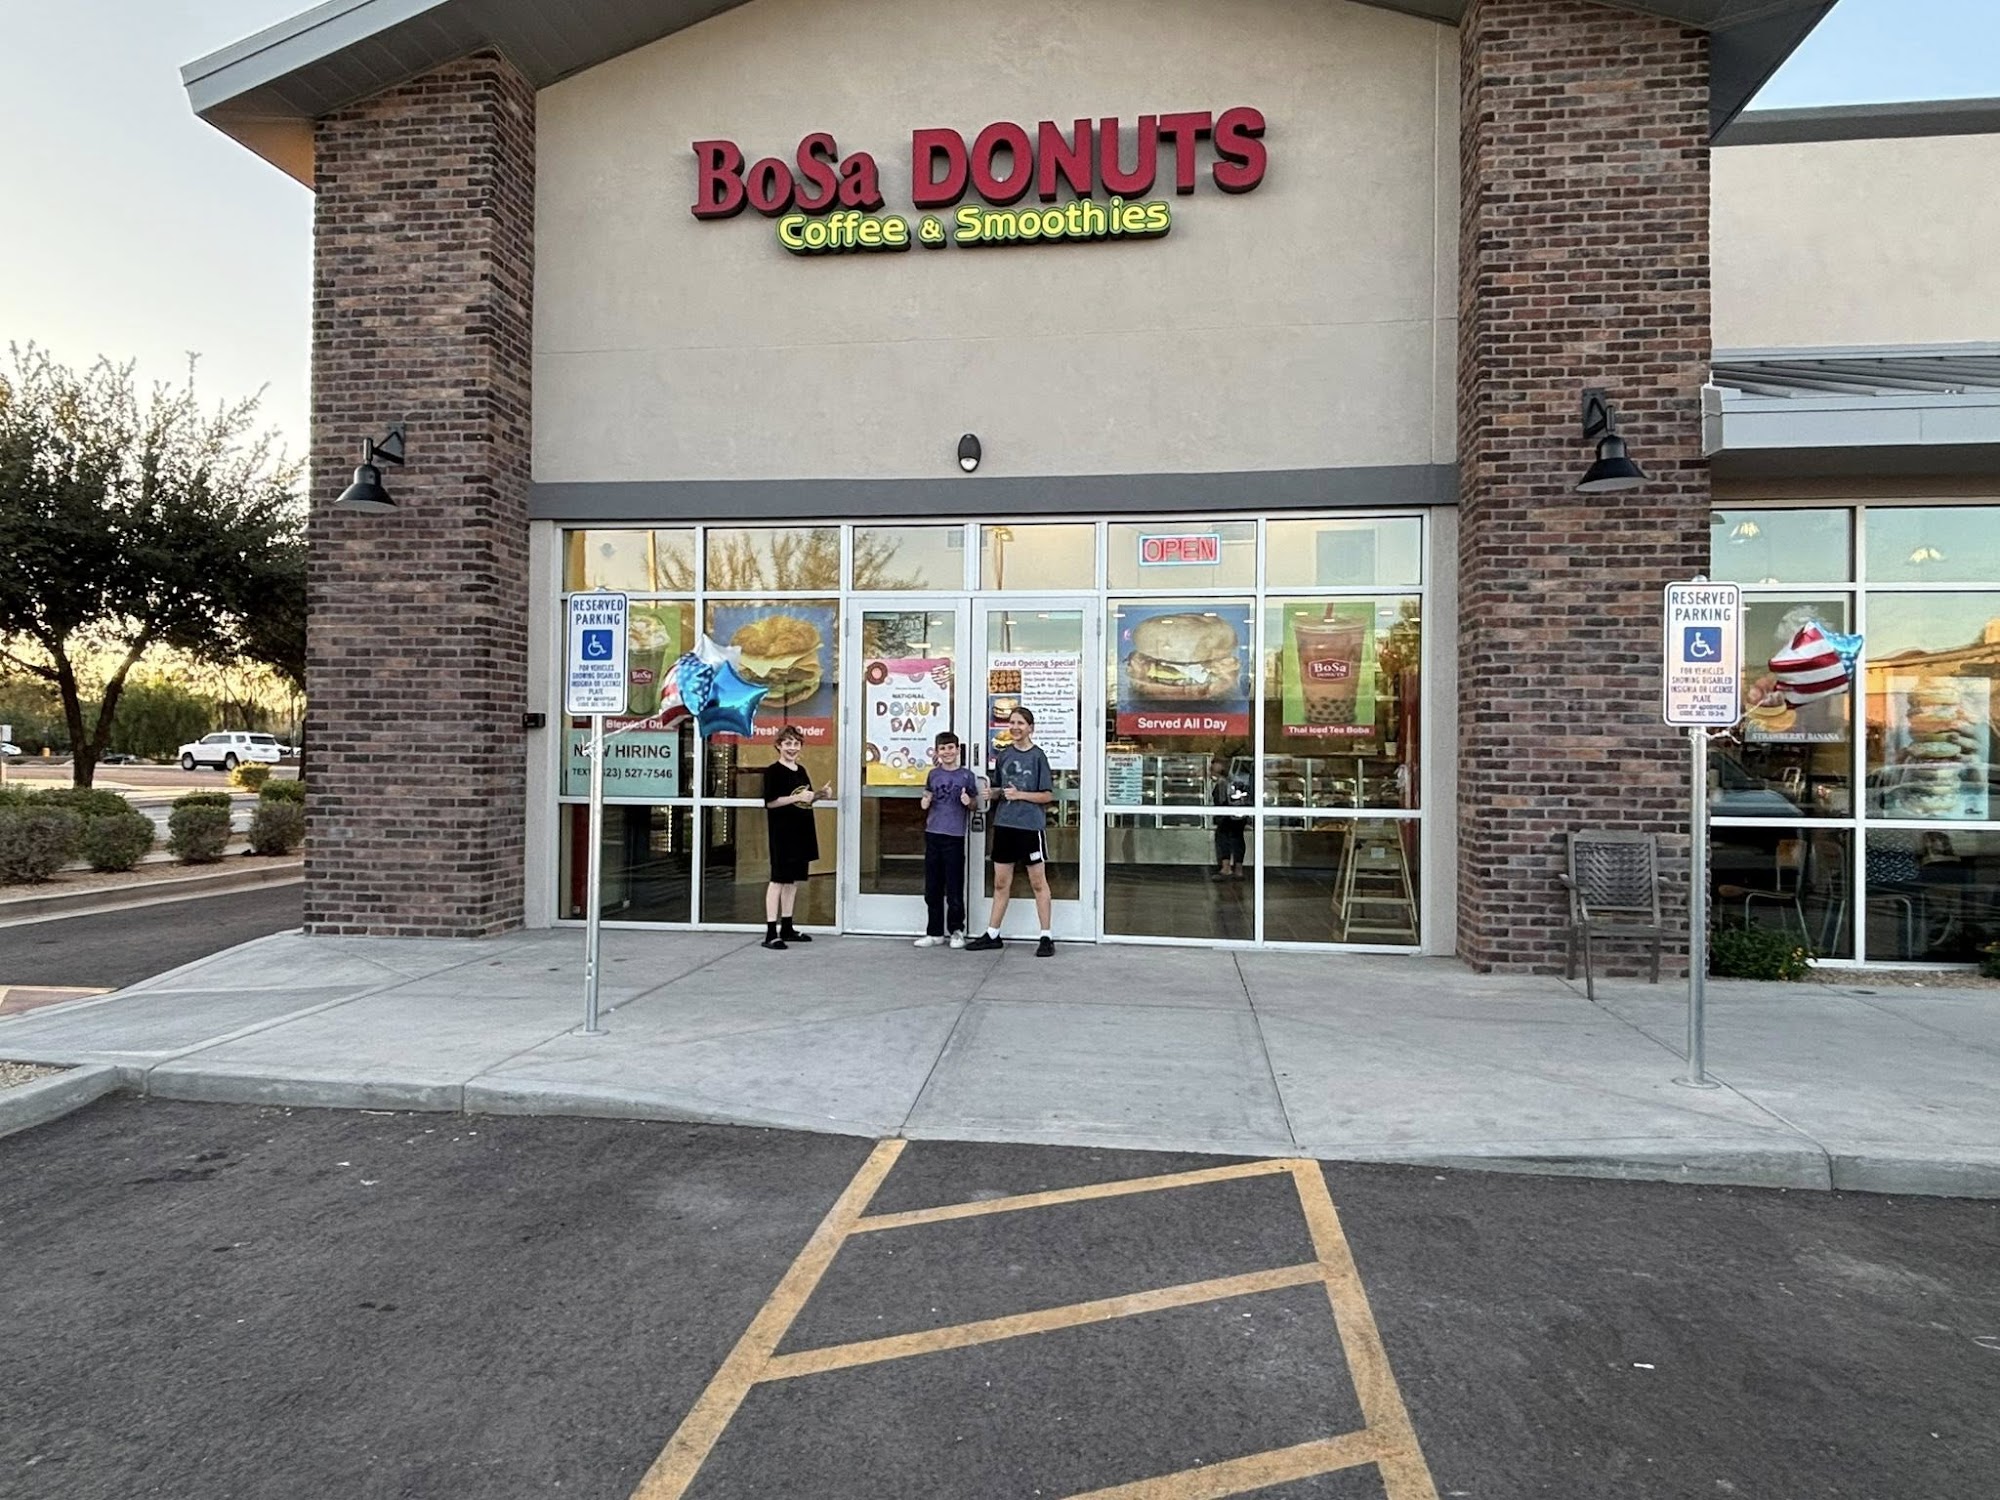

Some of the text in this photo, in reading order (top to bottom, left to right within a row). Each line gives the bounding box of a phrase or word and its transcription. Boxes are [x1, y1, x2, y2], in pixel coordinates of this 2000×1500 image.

[692, 107, 1267, 219] BoSa DONUTS
[777, 198, 1171, 250] Coffee & Smoothies
[1144, 537, 1216, 562] OPEN
[1671, 591, 1735, 605] RESERVED
[573, 600, 624, 611] RESERVED
[576, 613, 620, 625] PARKING
[1675, 608, 1731, 621] PARKING
[1018, 660, 1048, 668] Opening
[1314, 663, 1347, 672] BoSa
[1680, 667, 1725, 675] FOR VEHICLES
[1672, 676, 1733, 685] SHOWING DISABLED
[1709, 686, 1734, 694] LICENSE
[1692, 695, 1711, 703] PLATE
[876, 701, 941, 717] DONUT
[890, 718, 927, 733] DAY
[1138, 717, 1228, 731] Served All Day
[616, 745, 671, 758] HIRING
[625, 769, 673, 778] 527-7546
